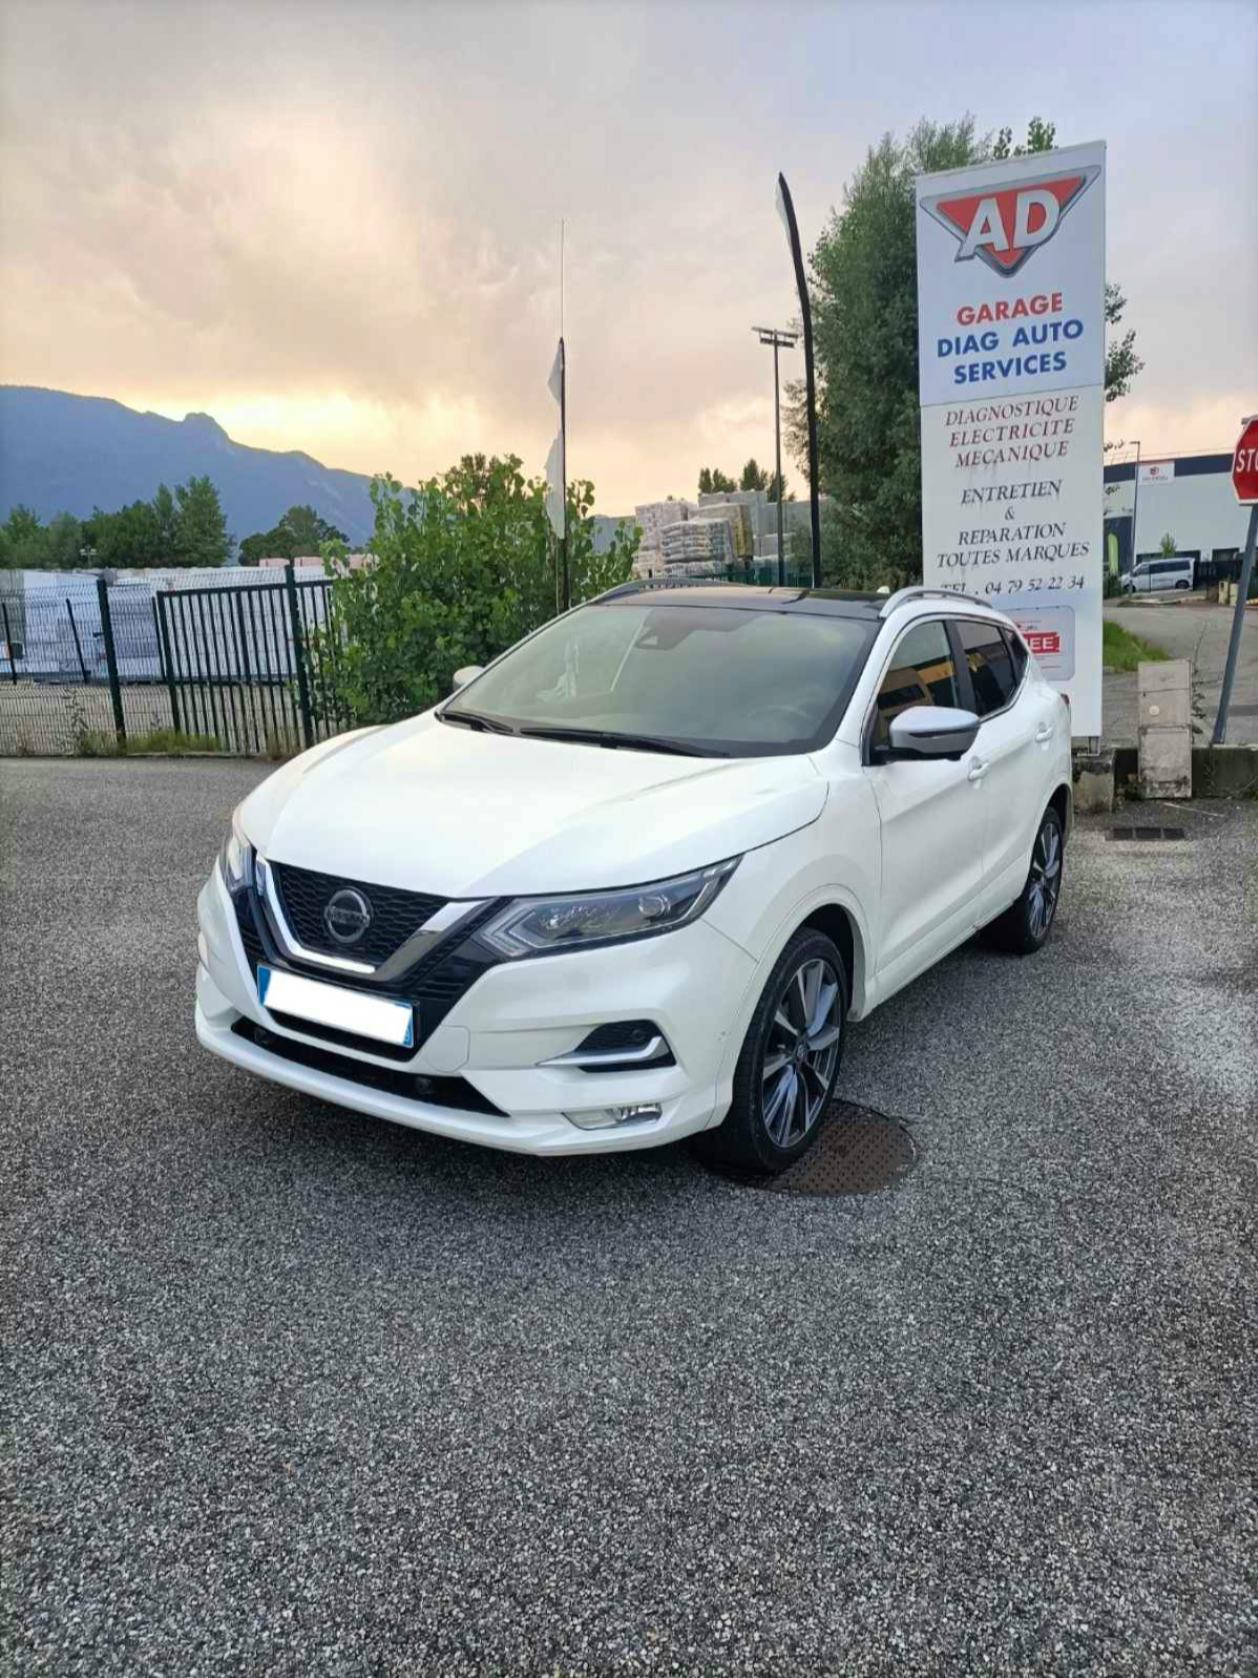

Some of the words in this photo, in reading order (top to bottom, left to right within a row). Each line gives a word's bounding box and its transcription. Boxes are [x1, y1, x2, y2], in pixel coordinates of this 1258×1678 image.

[955, 189, 1060, 262] AD
[957, 292, 1063, 326] GARAGE
[937, 331, 999, 358] DIAG
[1012, 319, 1083, 347] AUTO
[954, 351, 1067, 384] SERVICES
[945, 395, 1079, 426] DIAGNOSTIQUE
[950, 418, 1075, 447] ELECTRICITE
[955, 440, 1069, 468] MECANIQUE
[961, 479, 1063, 504] ENTRETIEN
[1004, 506, 1015, 520] &
[958, 522, 1067, 546] REPARATION
[937, 549, 1000, 568] TOUTES
[1005, 541, 1090, 563] MARQUES
[985, 581, 1002, 595] 04
[1008, 579, 1023, 594] 79
[1027, 576, 1043, 591] 52
[1047, 576, 1063, 590] 22
[1067, 575, 1084, 589] 34
